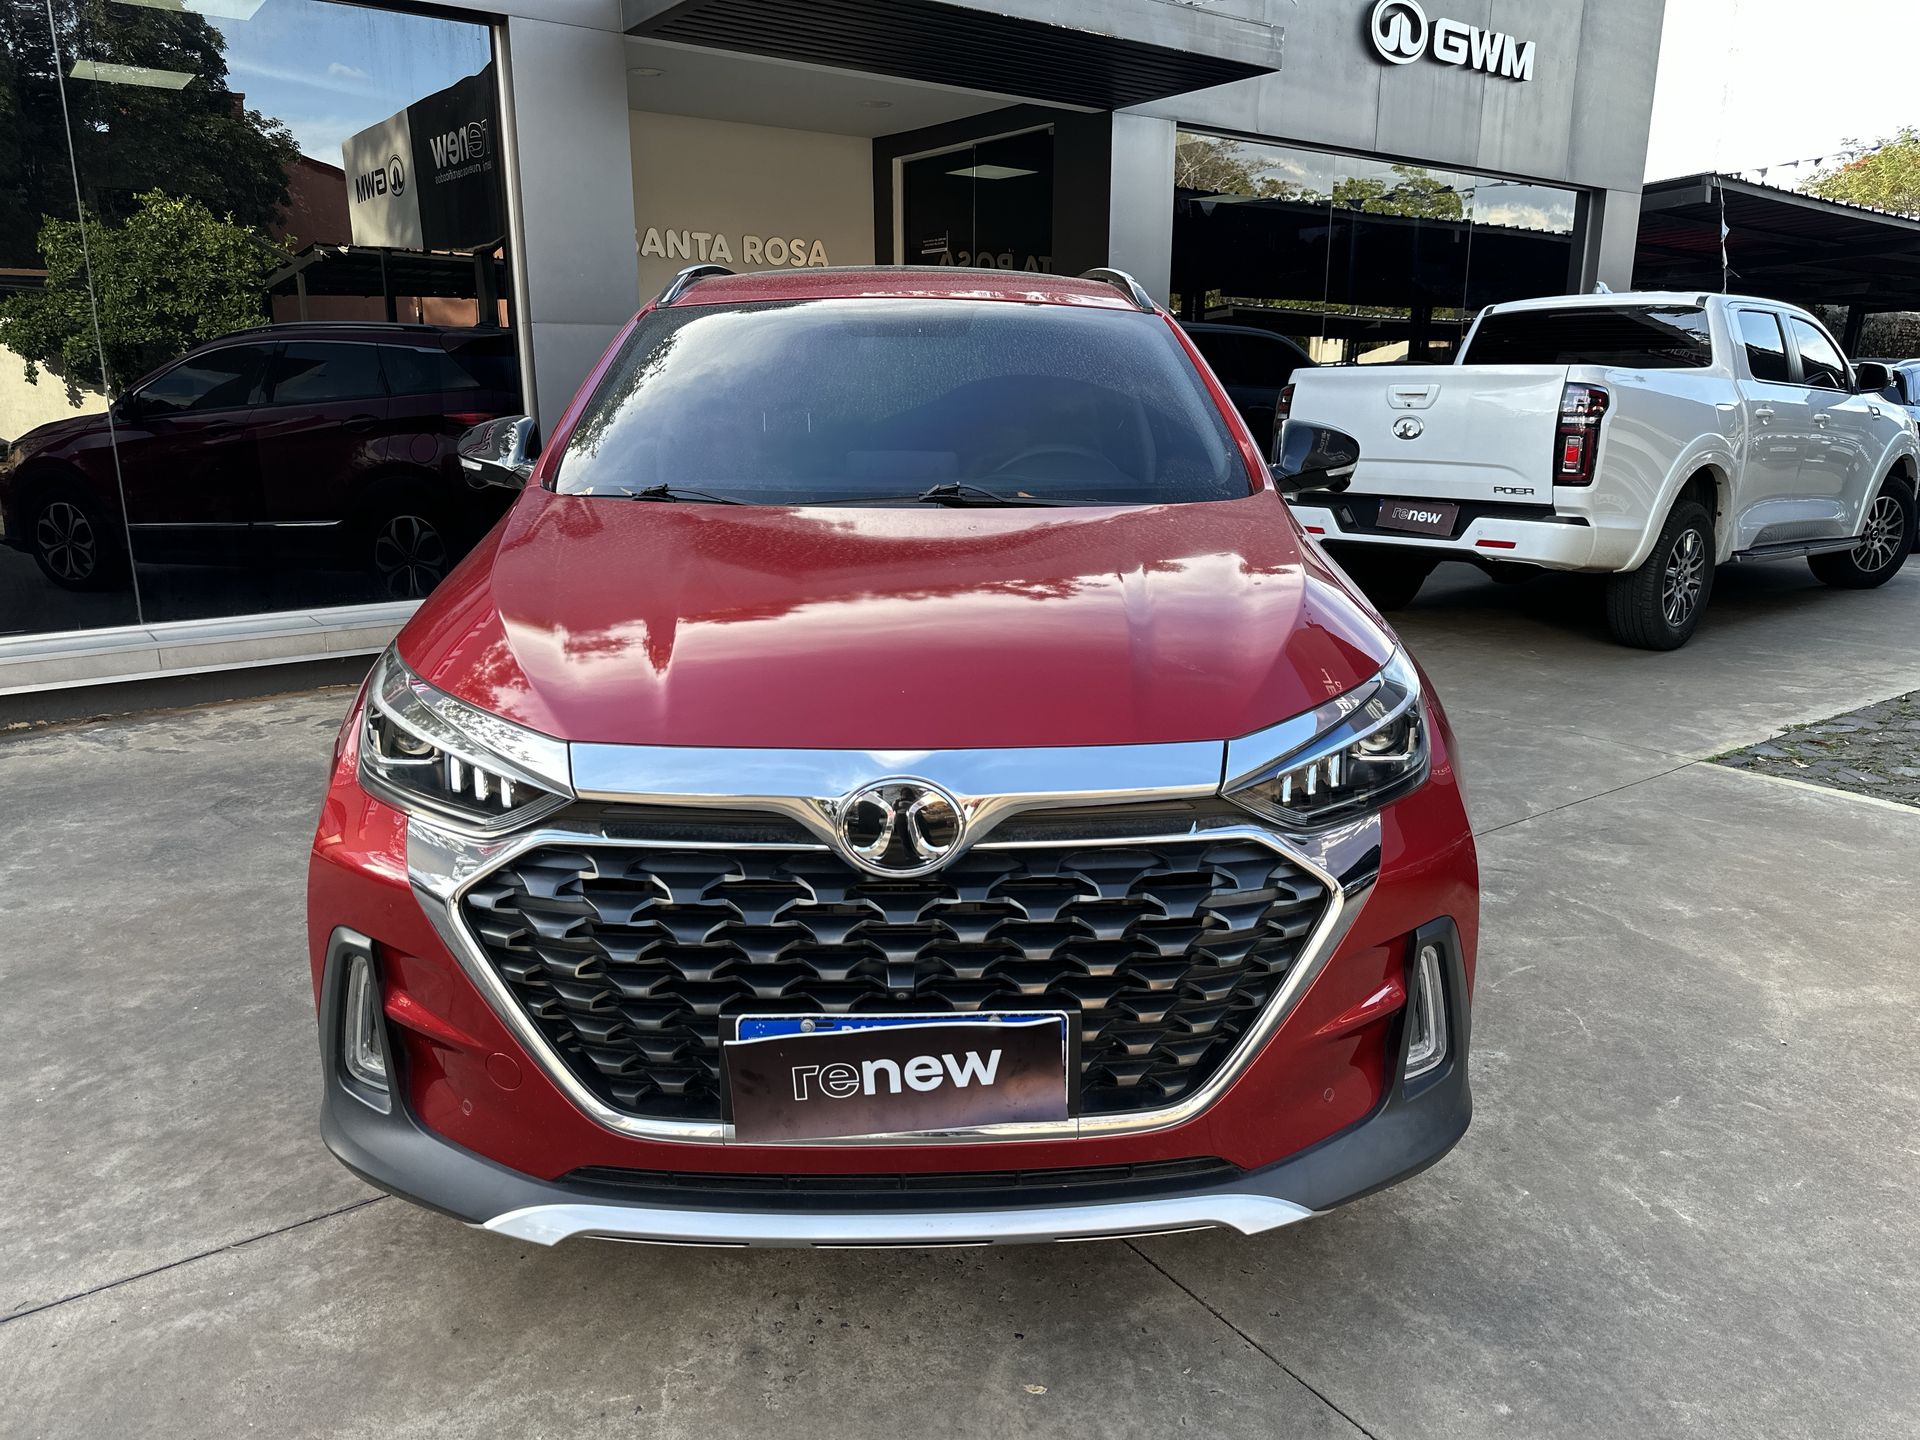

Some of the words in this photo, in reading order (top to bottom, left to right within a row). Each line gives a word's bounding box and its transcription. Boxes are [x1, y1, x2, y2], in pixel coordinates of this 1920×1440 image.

[1434, 17, 1536, 82] GWM
[635, 227, 733, 264] ANTA
[742, 235, 829, 267] ROSA
[1493, 486, 1535, 496] POER
[1391, 507, 1442, 524] renew
[791, 1049, 1002, 1100] renew
